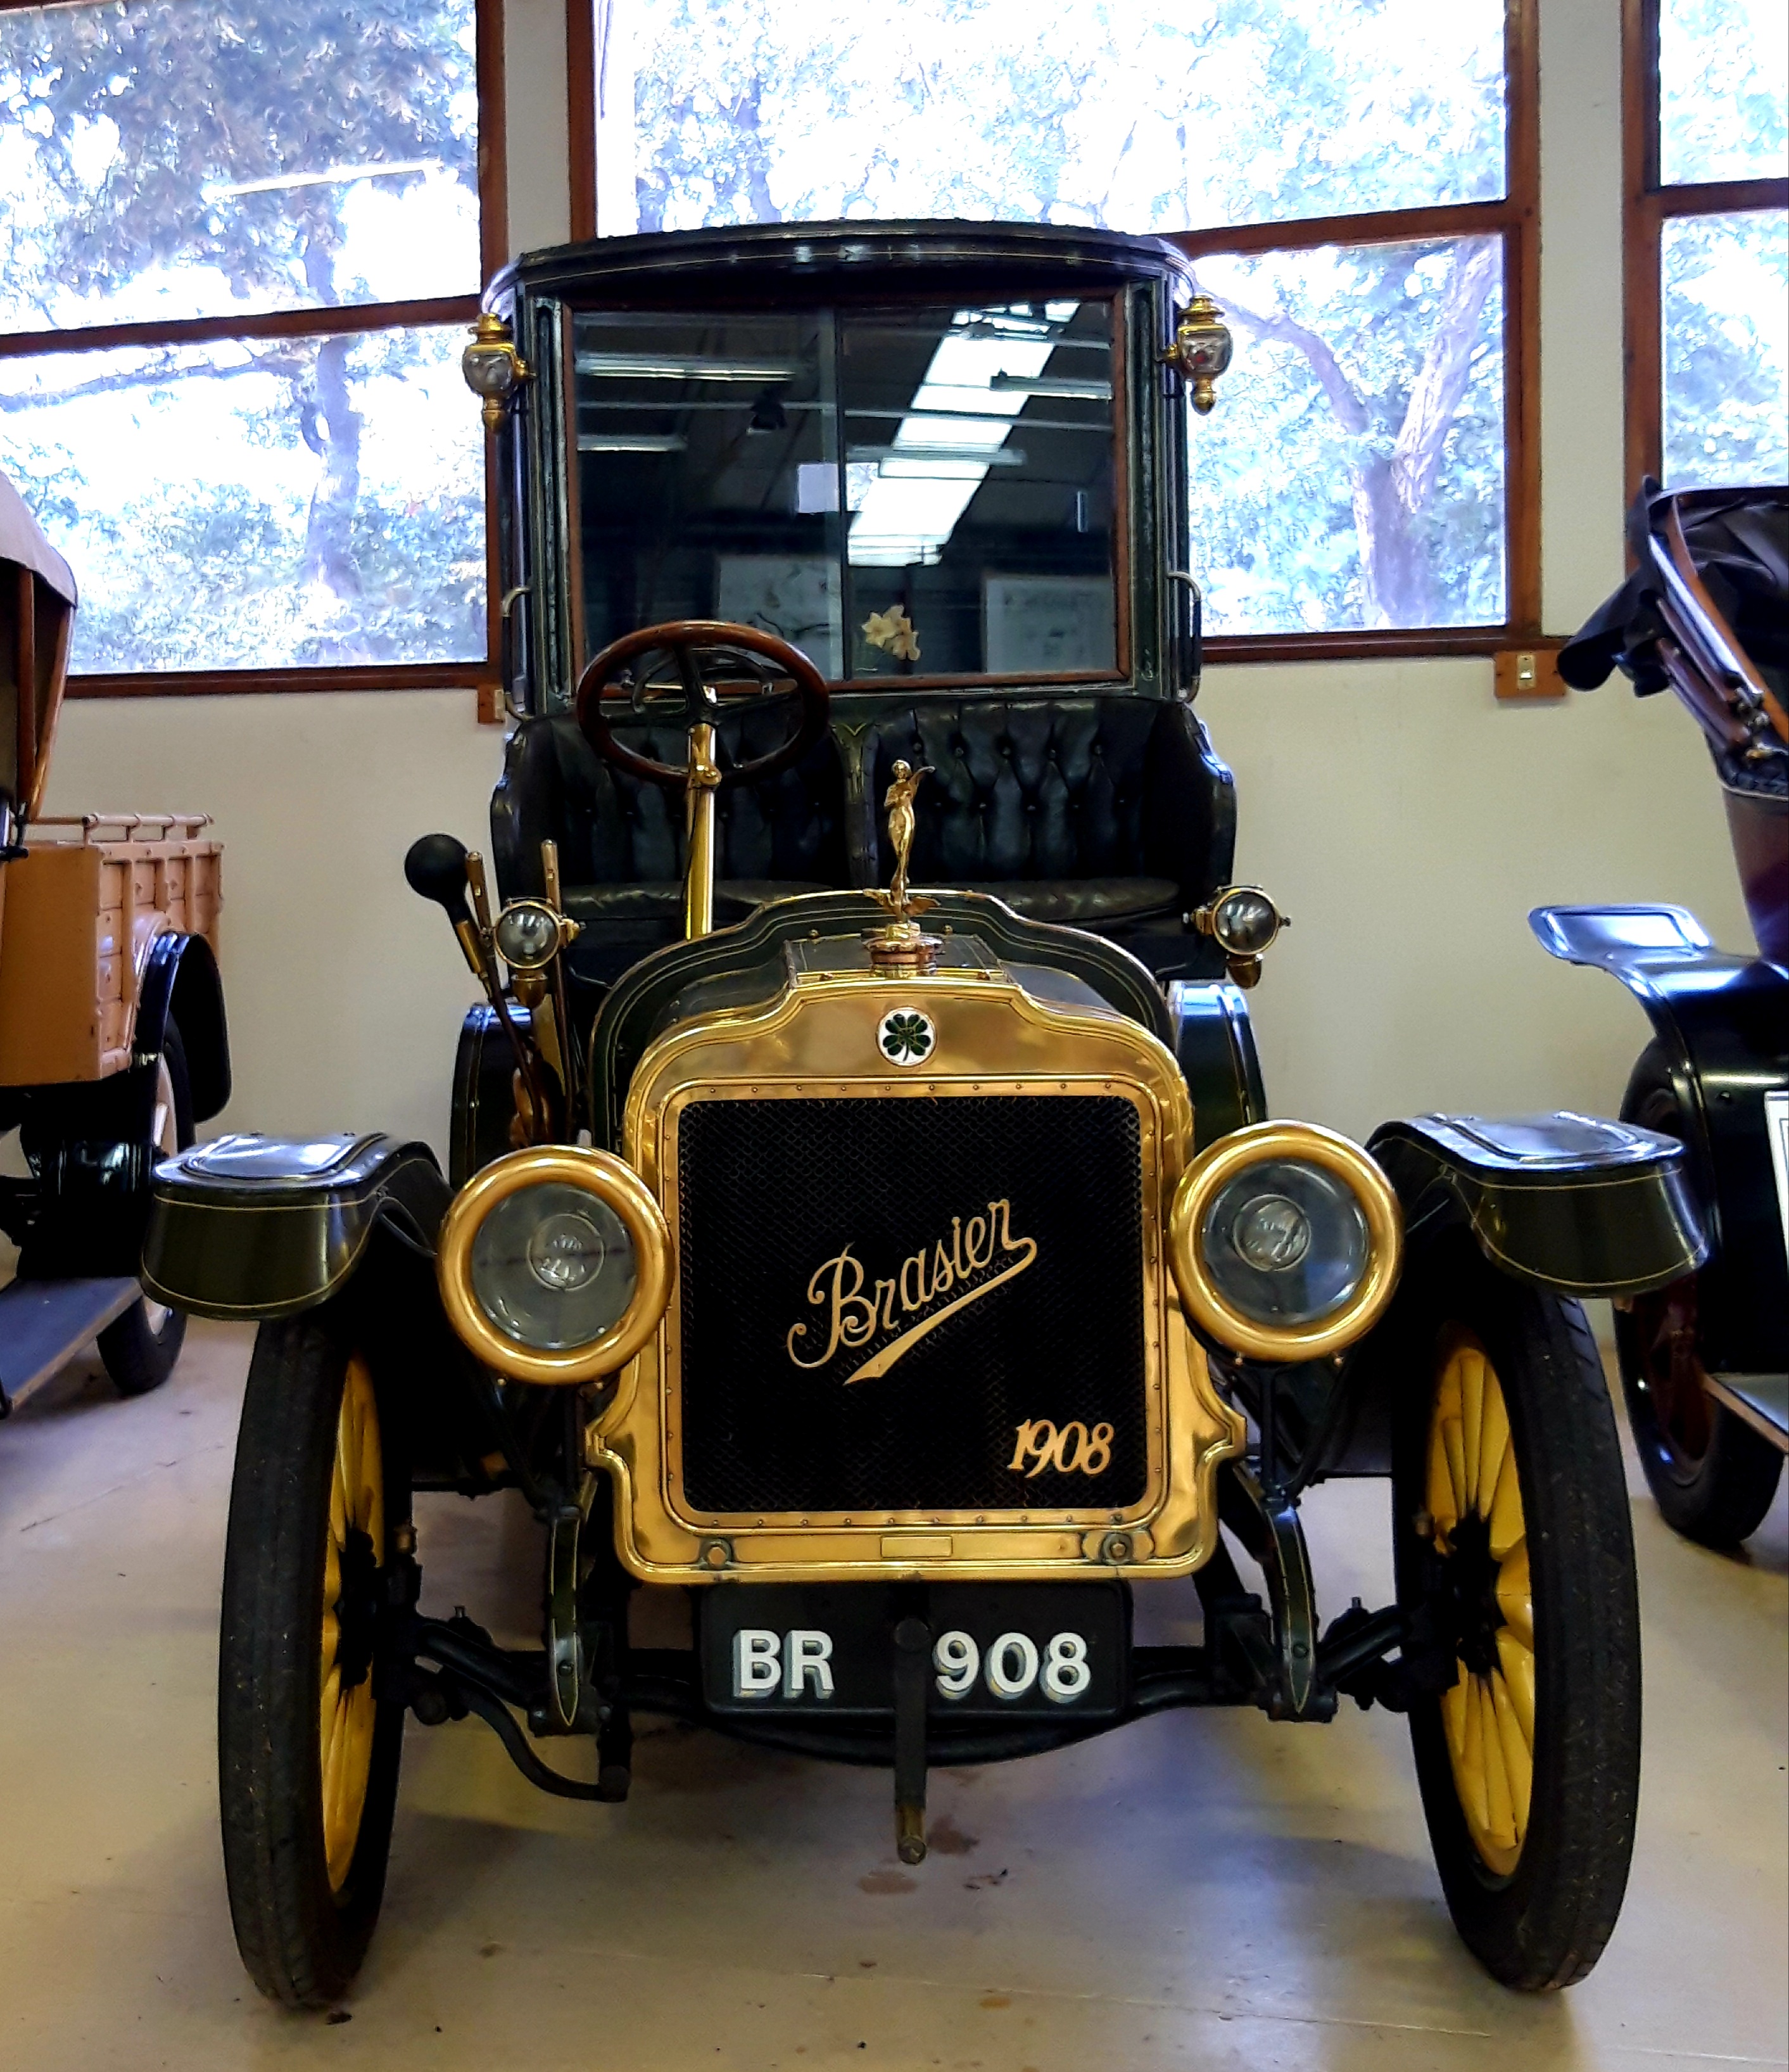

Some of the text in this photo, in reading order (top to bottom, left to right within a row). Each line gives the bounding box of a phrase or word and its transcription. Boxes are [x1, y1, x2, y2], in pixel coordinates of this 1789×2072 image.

[787, 1199, 1038, 1385] Brasier
[1006, 1418, 1115, 1478] 1908
[733, 1629, 1091, 1704] BR 908
